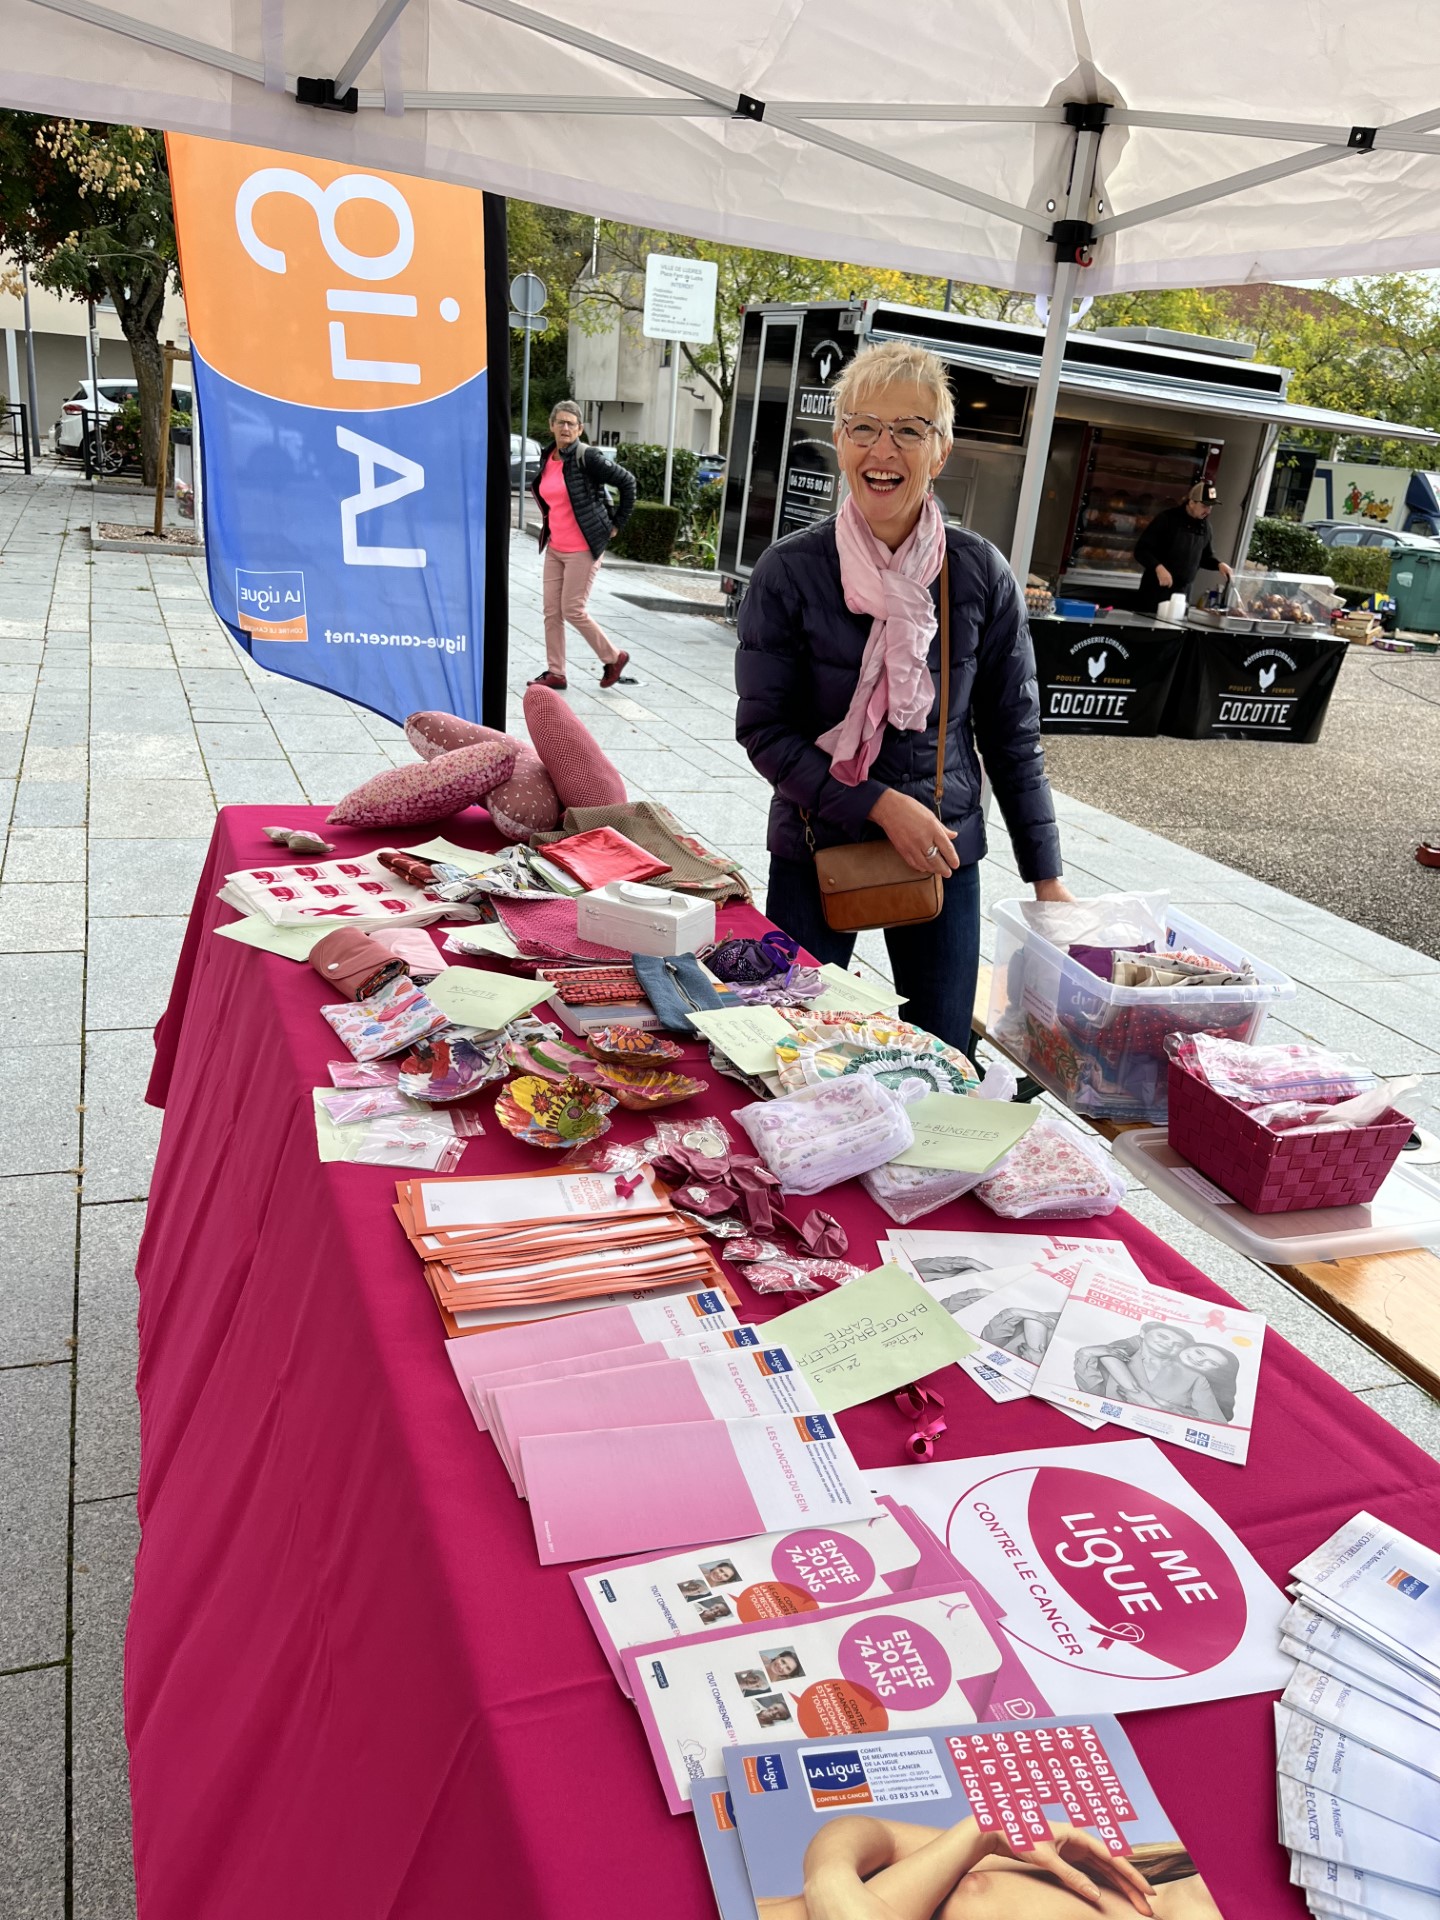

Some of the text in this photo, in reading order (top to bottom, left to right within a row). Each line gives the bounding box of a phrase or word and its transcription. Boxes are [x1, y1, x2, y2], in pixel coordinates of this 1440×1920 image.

[806, 478, 814, 489] 55
[1056, 674, 1081, 683] POULET
[1103, 677, 1131, 685] FERMIER
[1050, 692, 1127, 716] COCOTTE
[1219, 701, 1291, 724] COCOTTE
[664, 1305, 675, 1318] LES
[876, 1302, 928, 1332] BADGE
[1089, 1299, 1138, 1319] DU SEIN
[1091, 1291, 1163, 1318] DU CANCER
[824, 1317, 873, 1343] CARTE
[728, 1362, 758, 1413] LES CANCERS
[766, 1426, 810, 1512] LES CANCERS DU SEIN
[820, 1538, 860, 1585] ENTRE
[1117, 1511, 1218, 1604] JE ME
[1345, 1535, 1370, 1558] CONTRE
[785, 1546, 826, 1594] 74 ANS
[806, 1547, 842, 1586] 50 ET
[973, 1501, 1084, 1656] CONTRE LE CANCER
[1314, 1561, 1342, 1583] CANCER
[650, 1585, 660, 1599] TOUT
[656, 1597, 678, 1630] COMPRENDRE
[854, 1635, 896, 1697] 74 ANS
[876, 1639, 915, 1688] 50 ET
[892, 1629, 935, 1689] ENTRE
[706, 1671, 736, 1739] TOUT COMPRENDRE EN
[833, 1682, 860, 1730] LE CANCER DU
[1309, 1675, 1329, 1704] CANCER
[812, 1694, 823, 1714] TOUS
[819, 1714, 830, 1730] LES
[816, 1685, 844, 1736] EST RECOMMAN
[824, 1683, 853, 1736] LA MAMMOGRA
[849, 1699, 867, 1726] CONTRE
[764, 1756, 772, 1767] LA
[860, 1746, 882, 1754] COMITÉ
[872, 1748, 934, 1760] MEURTHE-ET-MOSELLE
[992, 1732, 1022, 1782] selon
[1014, 1730, 1052, 1799] du sein
[1305, 1725, 1324, 1773] LE CANCER
[1332, 1748, 1345, 1774] Moselle
[808, 1766, 825, 1779] LA
[866, 1766, 889, 1774] CONTRE
[949, 1737, 994, 1826] de risque
[1034, 1729, 1087, 1822] du cancer
[1076, 1725, 1129, 1816] Modalités
[816, 1795, 839, 1803] CONTRE
[847, 1791, 870, 1800] CANCER
[874, 1794, 889, 1802] Tél.
[910, 1790, 919, 1798] 53
[930, 1788, 940, 1796] 14
[971, 1734, 1026, 1846] et le niveau
[1055, 1727, 1123, 1851] de dépistage
[1304, 1785, 1320, 1841] LE CANCER
[1332, 1808, 1344, 1838] Moselle
